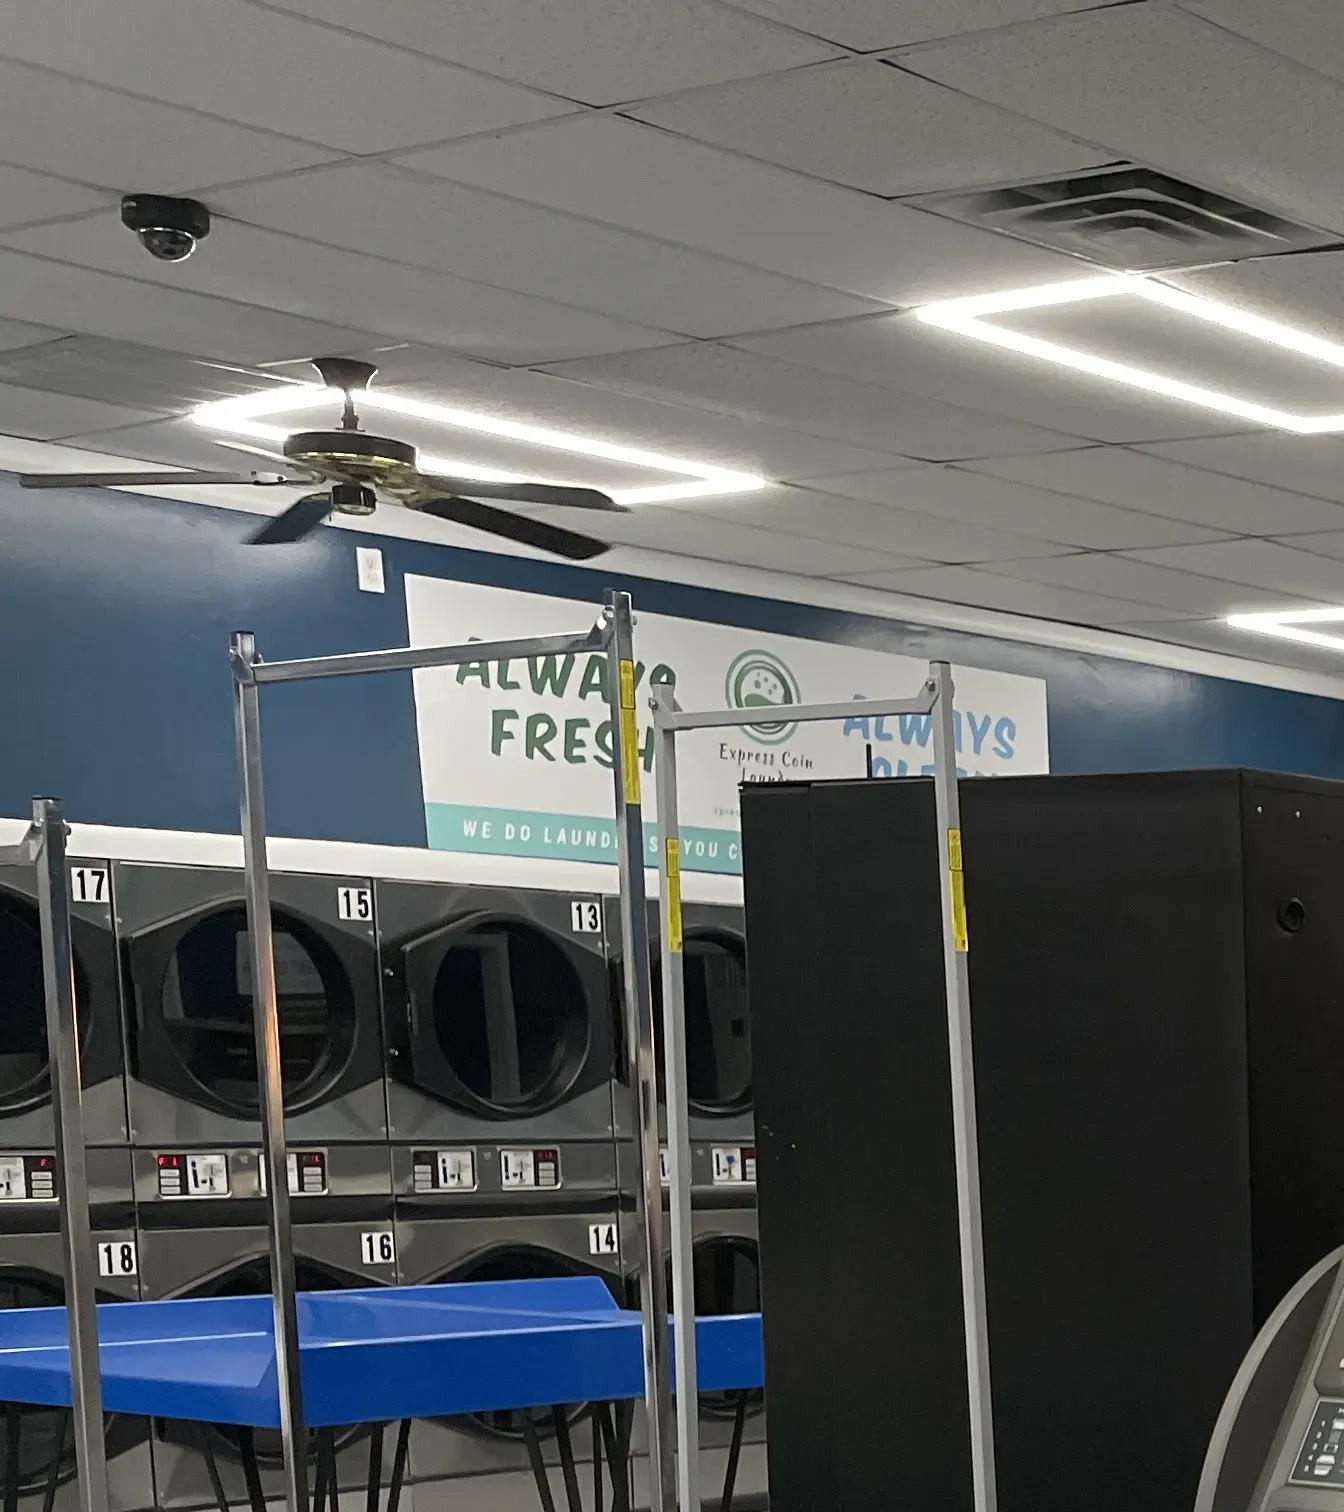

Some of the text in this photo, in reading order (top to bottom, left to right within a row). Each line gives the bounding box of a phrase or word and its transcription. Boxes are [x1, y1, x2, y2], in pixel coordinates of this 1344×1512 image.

[455, 637, 677, 704] ALWA
[719, 742, 814, 769] Express Coin
[463, 819, 492, 839] WE
[504, 823, 531, 842] DO
[544, 828, 618, 849] LAUND
[684, 838, 719, 858] YOU
[75, 870, 106, 901] 17
[342, 889, 370, 919] 15
[575, 904, 599, 931] 13
[365, 1233, 392, 1262] 16
[592, 1225, 616, 1252] 14
[103, 1243, 134, 1275] 18
